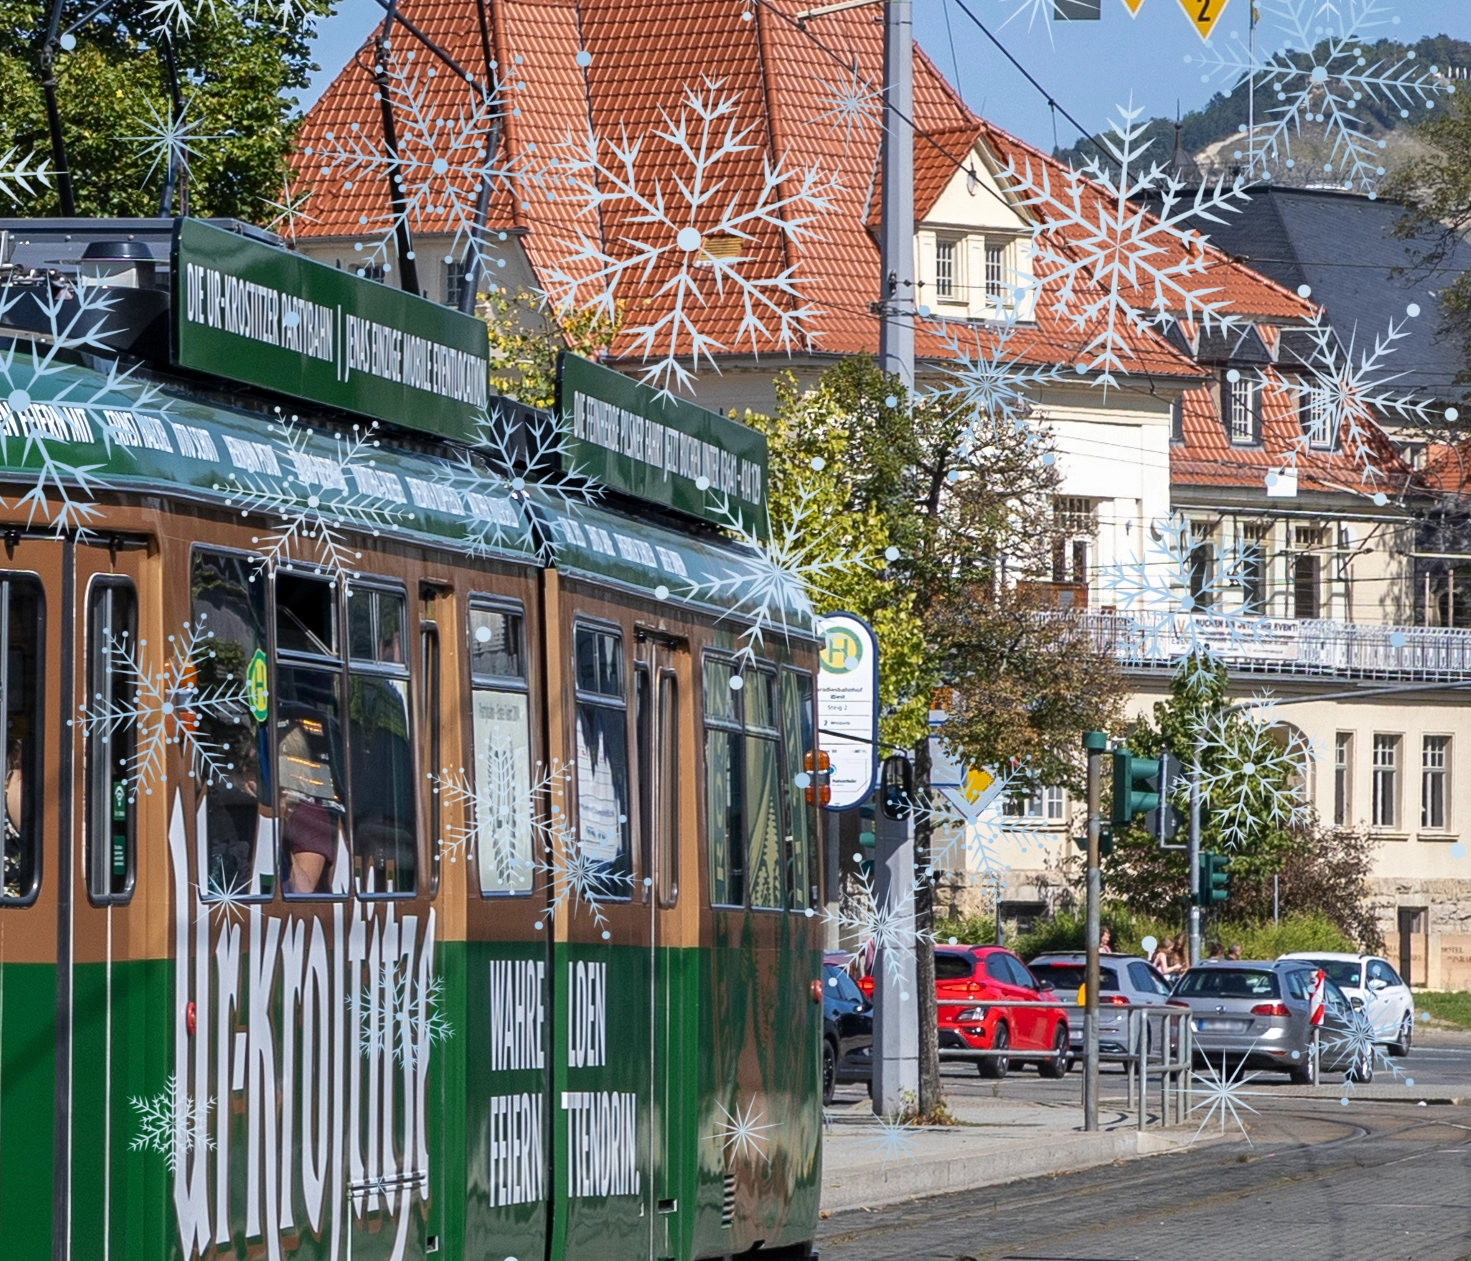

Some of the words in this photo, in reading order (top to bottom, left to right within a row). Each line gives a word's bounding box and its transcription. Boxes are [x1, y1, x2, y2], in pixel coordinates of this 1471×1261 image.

[186, 262, 205, 324] DIE
[206, 268, 279, 346] UR-KROSTITZER
[281, 292, 334, 362] PARTYBAHN
[344, 313, 370, 383] JENAS
[371, 322, 402, 382] EINZIGE
[403, 333, 432, 392] MOBILE
[63, 407, 95, 444] MIT
[828, 638, 848, 663] H
[489, 959, 545, 1071] WAHRE
[567, 960, 606, 1068] LDEN
[489, 1092, 543, 1208] FEIERN
[561, 1091, 641, 1198] TTENDRIN.
